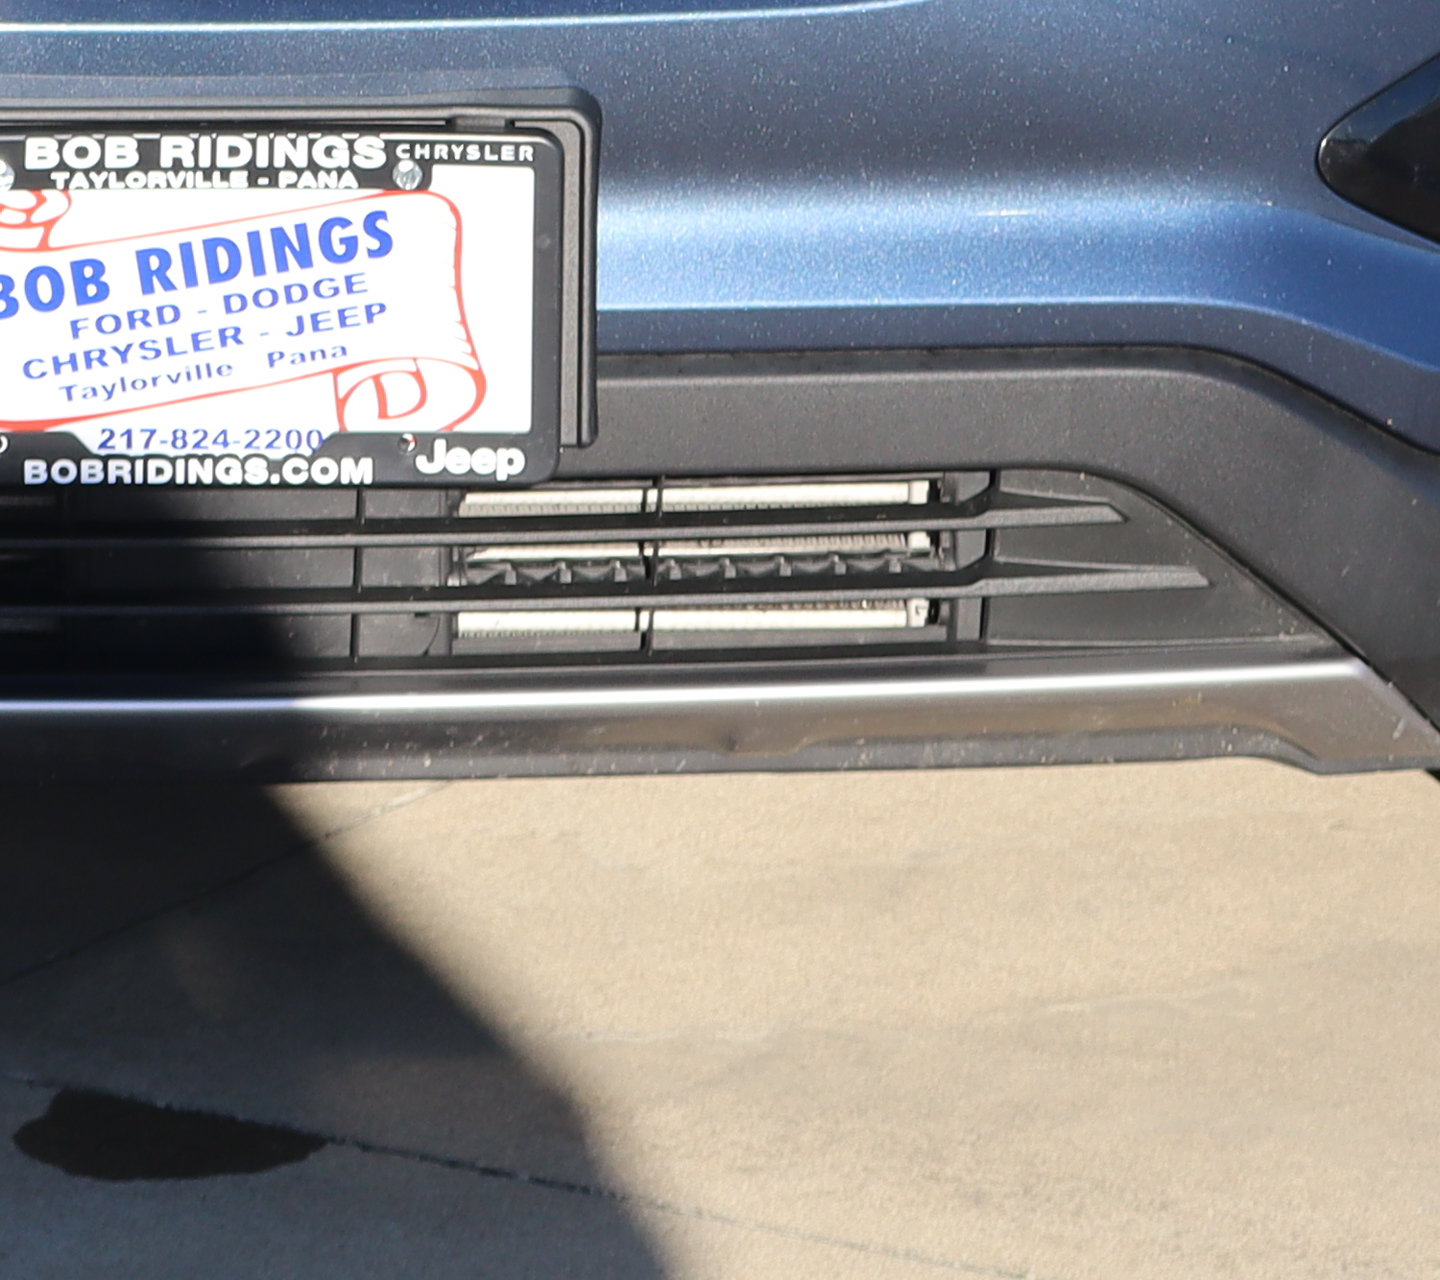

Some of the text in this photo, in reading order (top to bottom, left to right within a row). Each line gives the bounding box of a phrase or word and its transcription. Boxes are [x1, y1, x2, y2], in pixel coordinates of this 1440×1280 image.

[24, 134, 387, 170] BOB RIDINGS
[395, 143, 534, 162] CHRYSLER
[50, 170, 249, 190] TAYLORVILLE
[277, 170, 359, 189] PANA
[135, 210, 393, 295] RIDINGS
[70, 304, 181, 340] FORD
[223, 272, 369, 315] DODGE
[22, 326, 245, 380] CHRYSLER
[285, 301, 388, 338] JEEP
[58, 344, 349, 402] Taylorville Pana
[97, 428, 324, 451] 217-824-2200
[23, 456, 373, 485] BOBRIDINGS.COM
[415, 438, 526, 481] Jeep
